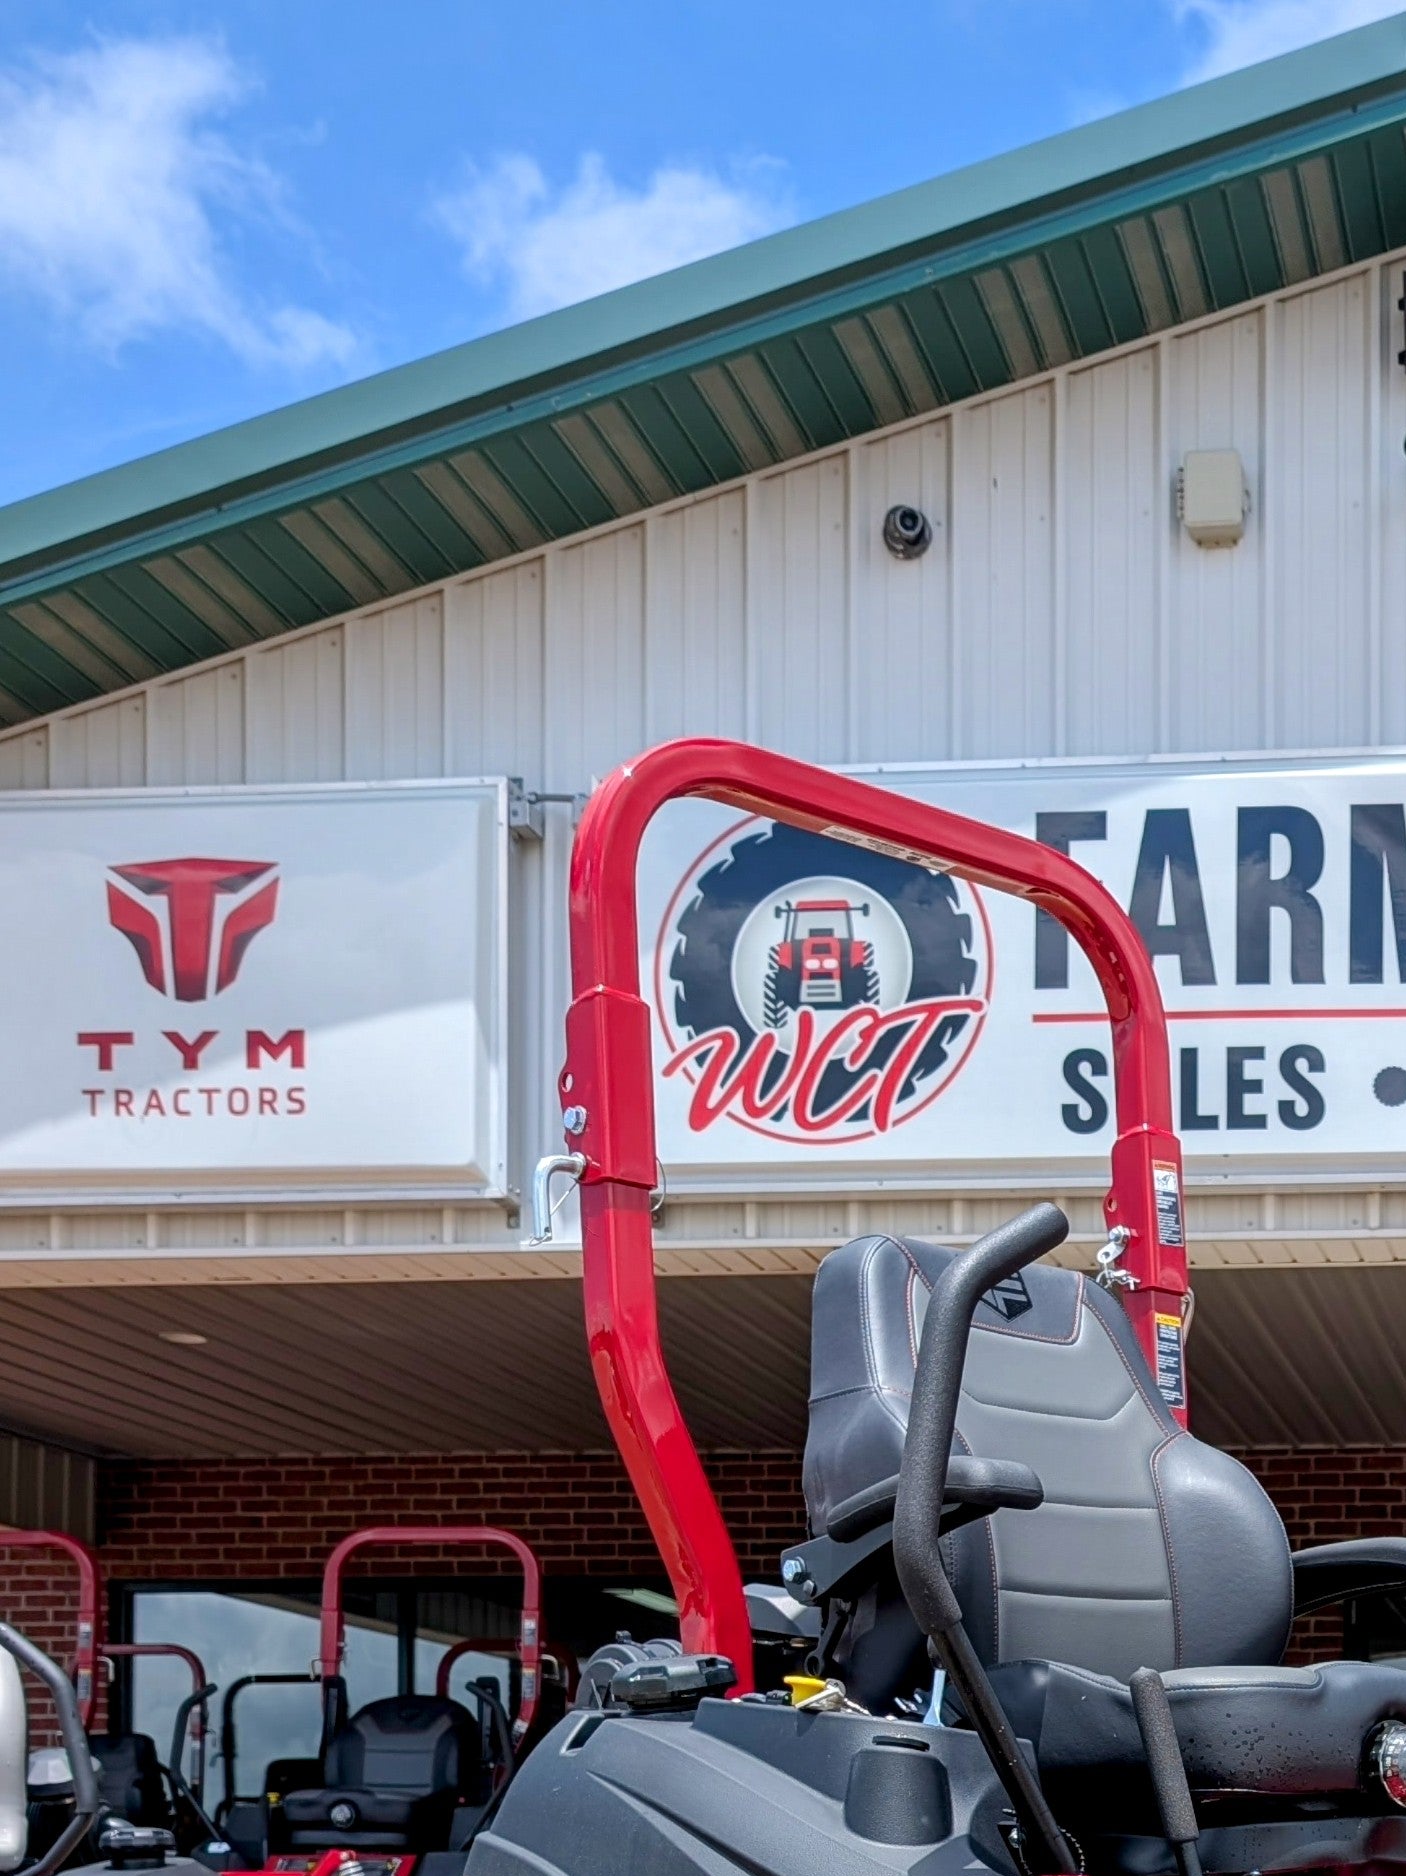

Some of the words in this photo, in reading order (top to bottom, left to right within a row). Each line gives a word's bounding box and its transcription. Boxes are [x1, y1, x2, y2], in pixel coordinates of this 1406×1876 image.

[77, 1029, 306, 1070] TYM
[661, 998, 985, 1133] WCT
[82, 1086, 306, 1117] TRACTORS
[1061, 1043, 1326, 1134] SLES
